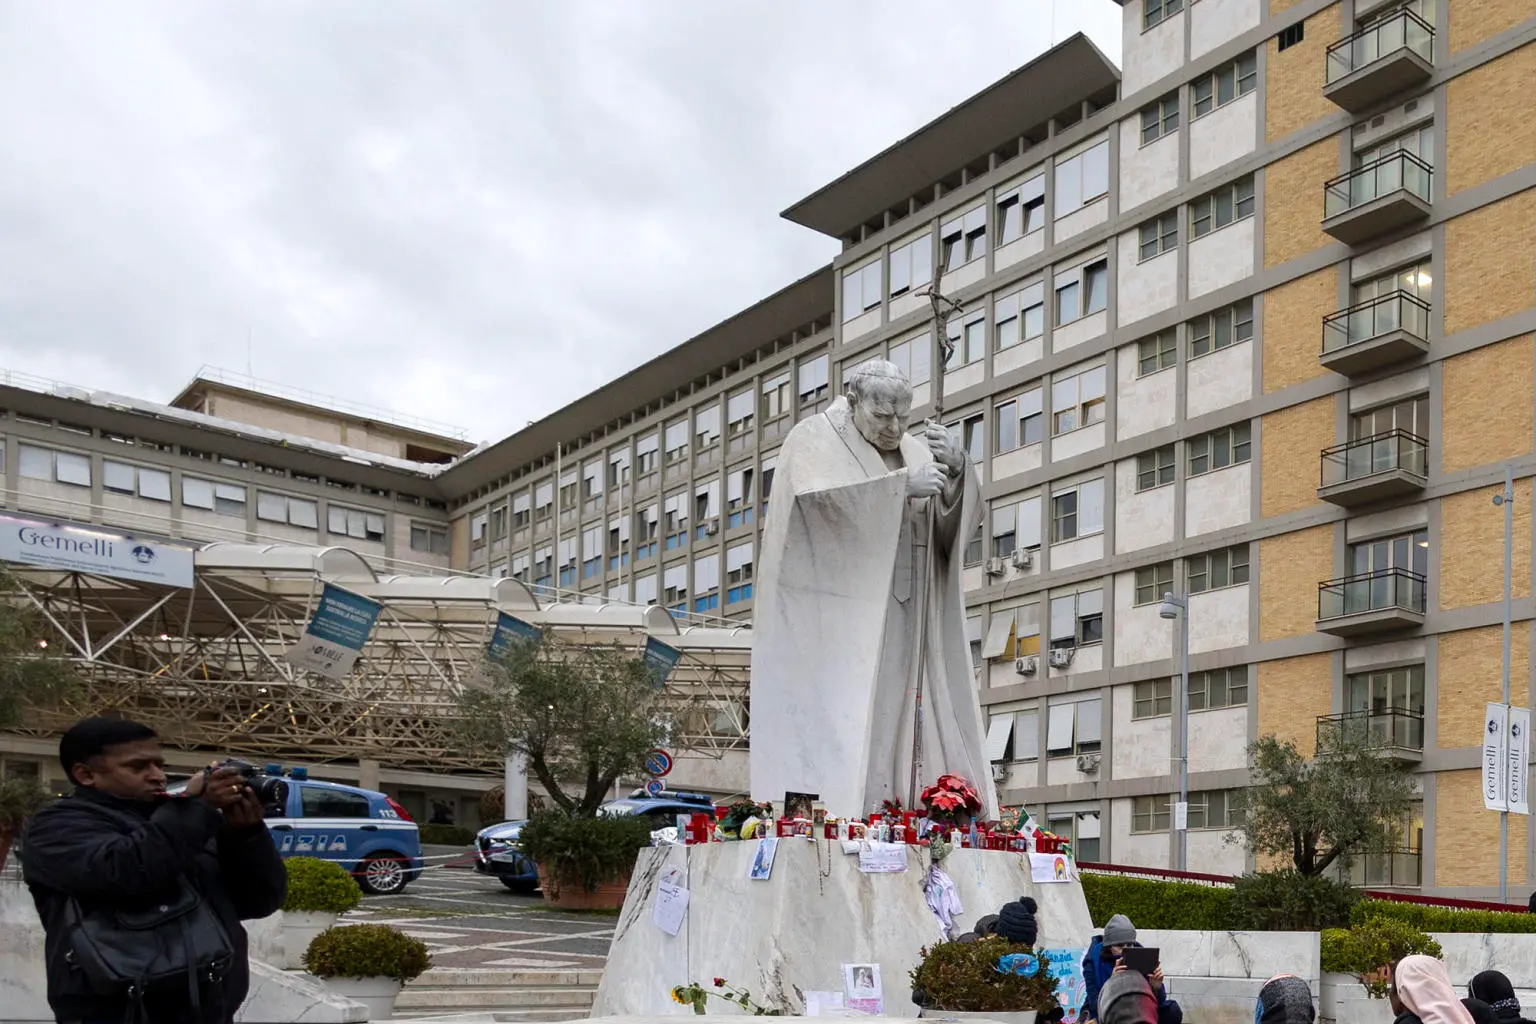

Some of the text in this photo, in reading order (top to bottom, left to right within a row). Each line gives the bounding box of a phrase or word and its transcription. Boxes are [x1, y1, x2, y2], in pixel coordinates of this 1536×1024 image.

[19, 526, 113, 558] Gemelli
[1486, 744, 1497, 801] Gemelli
[1510, 748, 1520, 803] Gemelli
[379, 809, 398, 818] 113
[280, 834, 348, 852] IZIA
